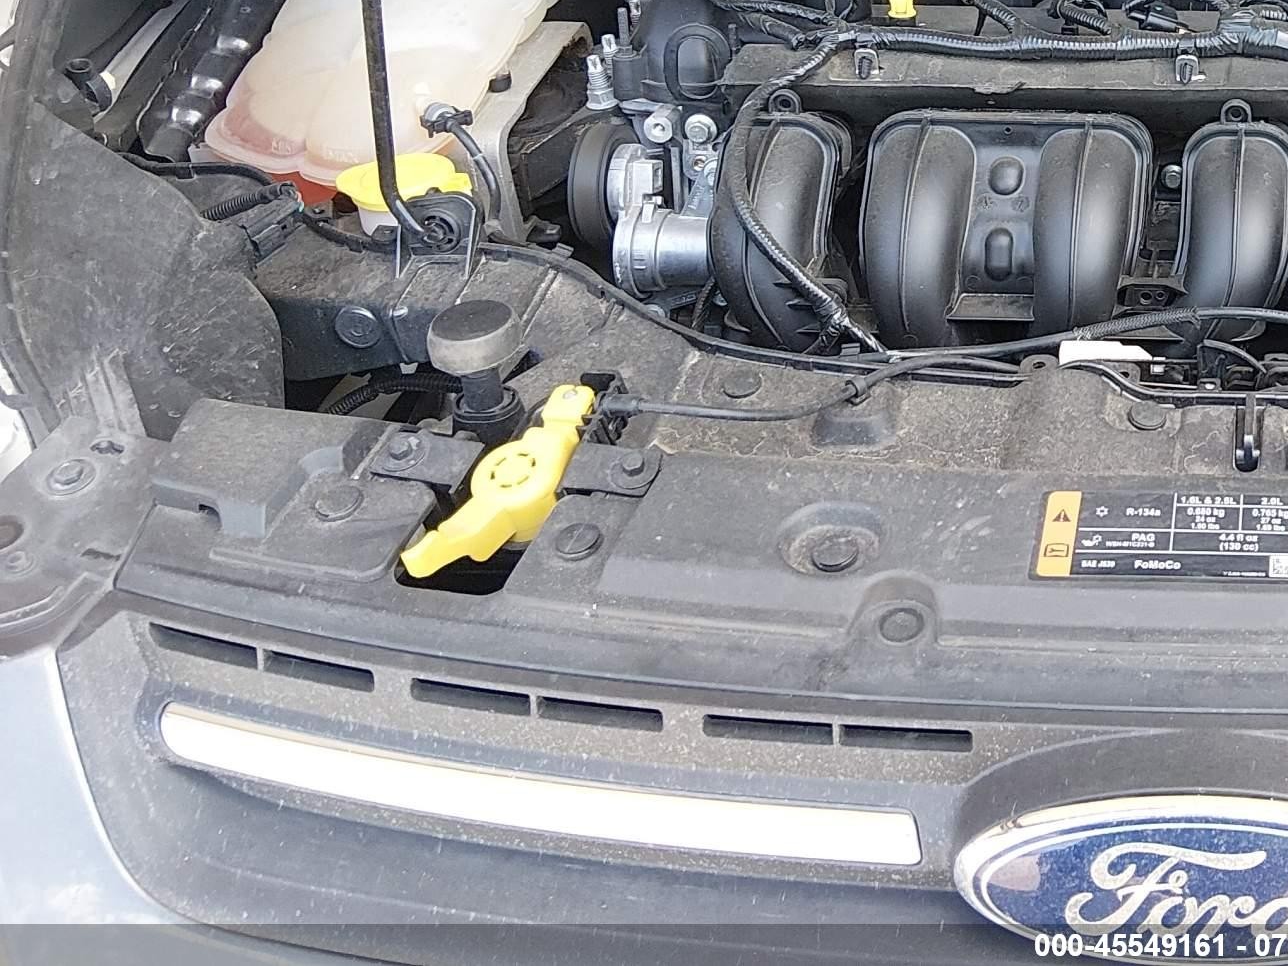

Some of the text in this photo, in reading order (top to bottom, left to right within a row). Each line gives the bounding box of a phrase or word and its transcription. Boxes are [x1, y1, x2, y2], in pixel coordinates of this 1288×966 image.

[1261, 497, 1283, 505] 2.0L
[1126, 508, 1161, 516] R-134a
[1213, 508, 1225, 518] kg
[1252, 509, 1277, 517] 0.765
[1131, 533, 1155, 541] PAG
[1219, 534, 1235, 542] 4.4
[1219, 542, 1259, 551] (130 cc)
[1081, 560, 1097, 568] SAE
[1134, 559, 1181, 570] FoMoCo
